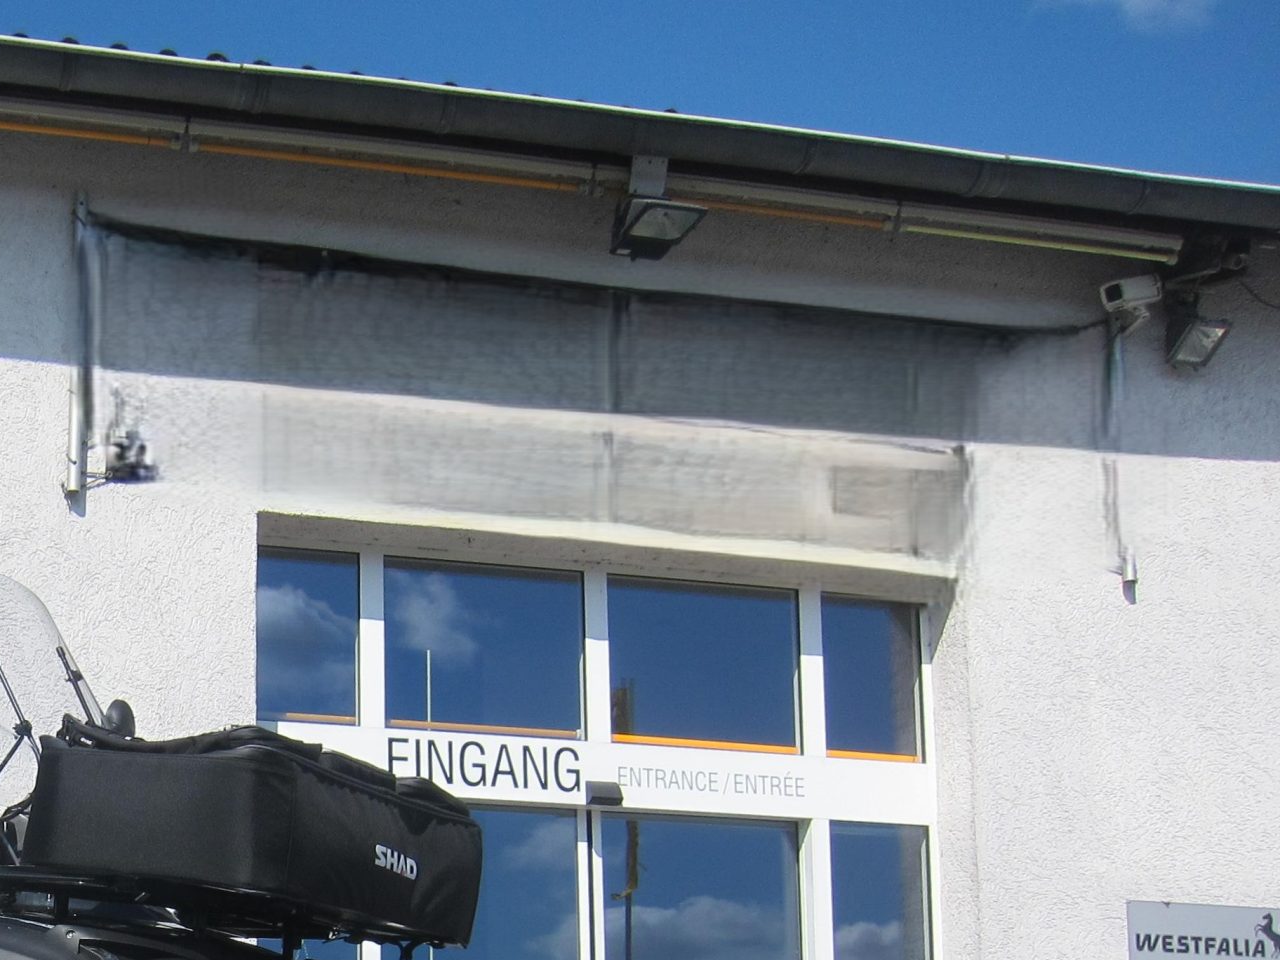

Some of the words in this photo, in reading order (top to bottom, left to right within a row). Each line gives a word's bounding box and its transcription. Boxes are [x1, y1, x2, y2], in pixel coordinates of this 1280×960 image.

[387, 736, 581, 793] EINGANG
[617, 766, 719, 793] ENTRANCE
[733, 771, 806, 798] ENTRÉE
[374, 844, 418, 880] SHAD
[1135, 932, 1266, 958] WESTFALIA
